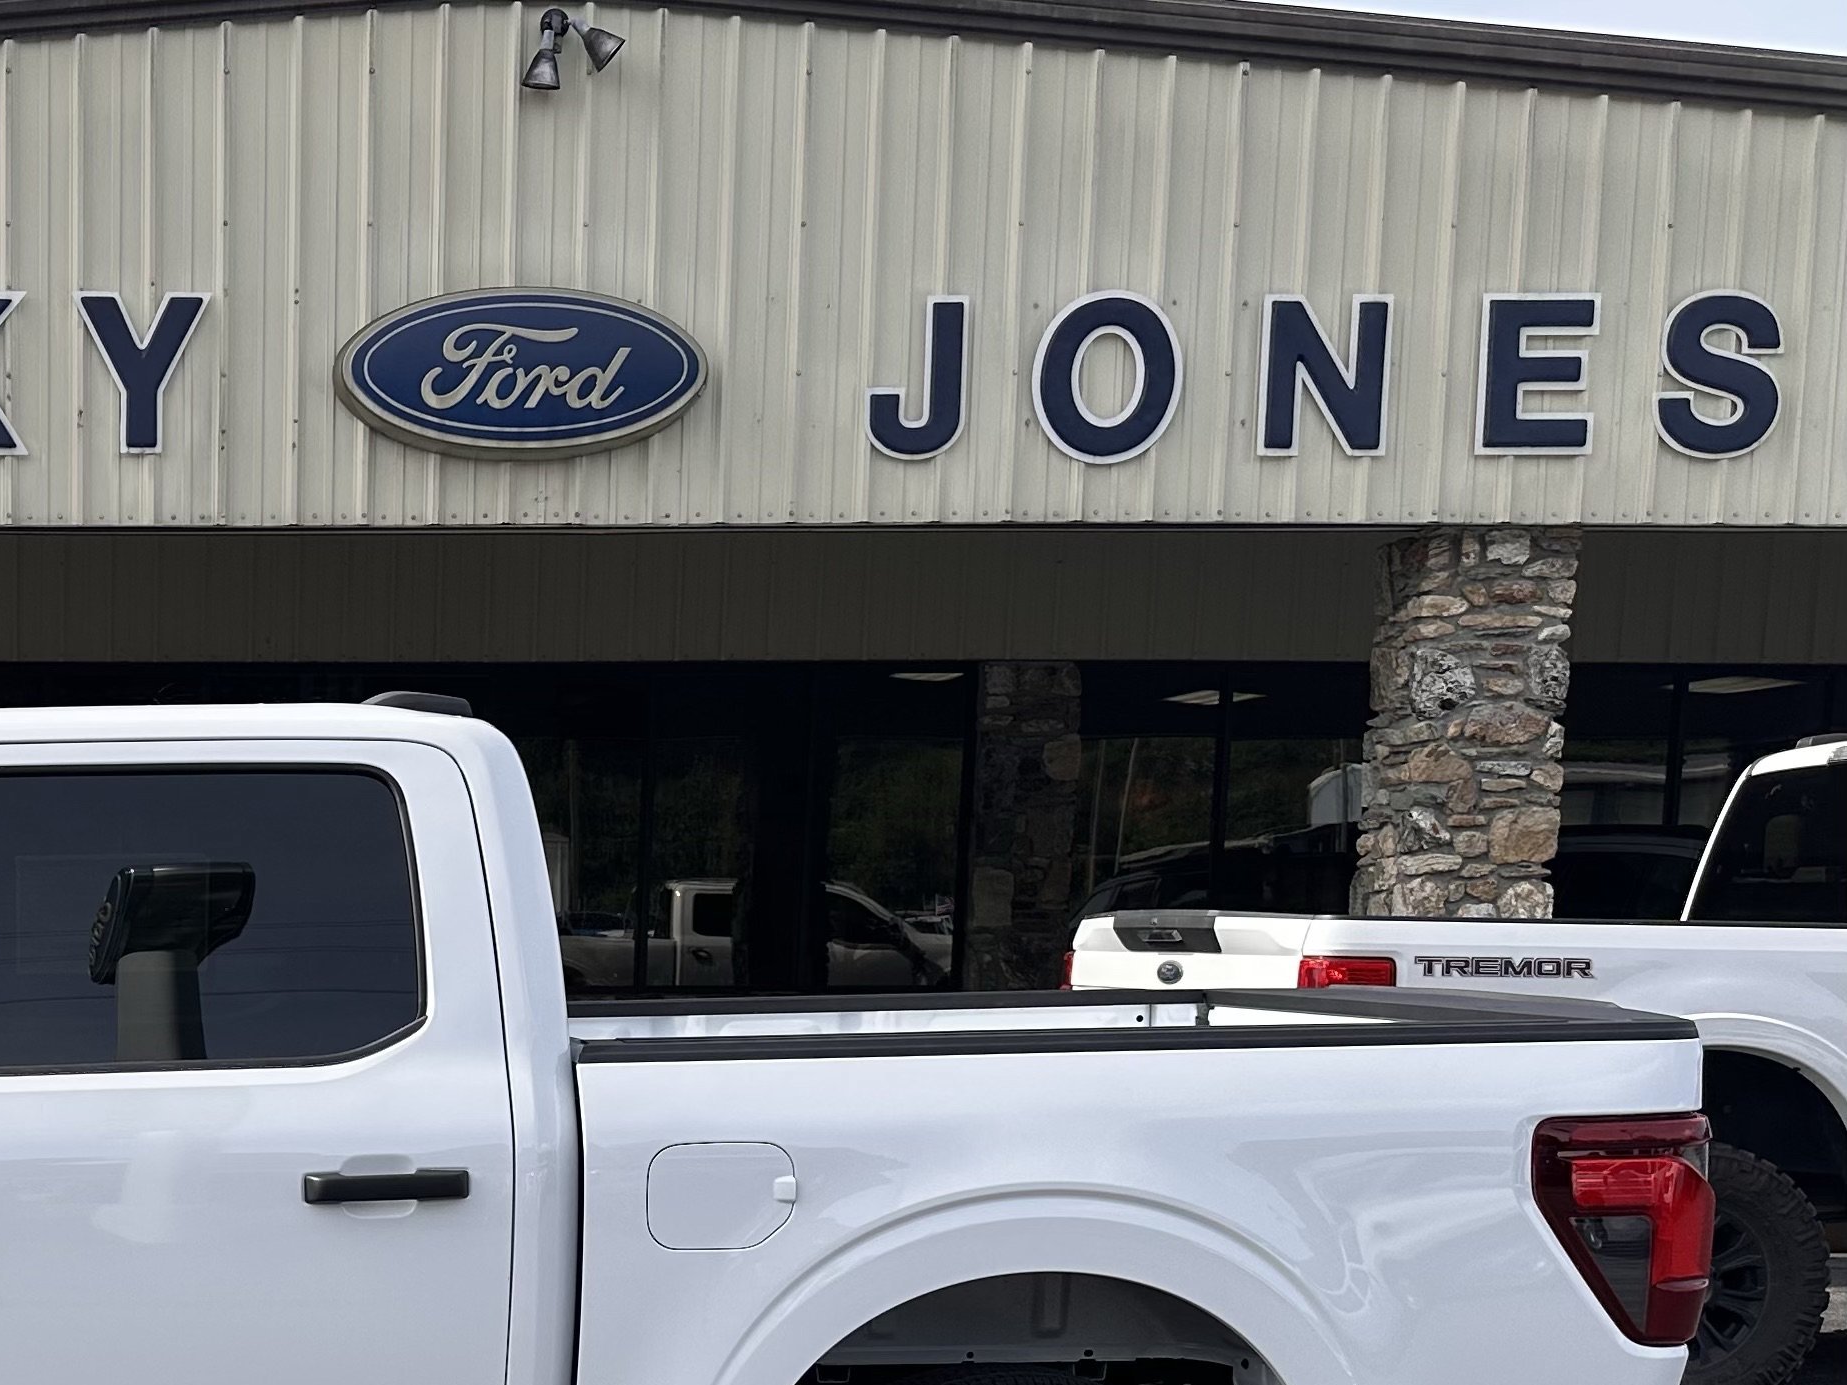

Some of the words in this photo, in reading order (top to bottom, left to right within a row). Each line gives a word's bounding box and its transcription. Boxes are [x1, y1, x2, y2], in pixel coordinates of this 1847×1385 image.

[420, 323, 633, 411] Ford
[865, 289, 1785, 464] JONES
[1414, 955, 1595, 979] TREMOR
